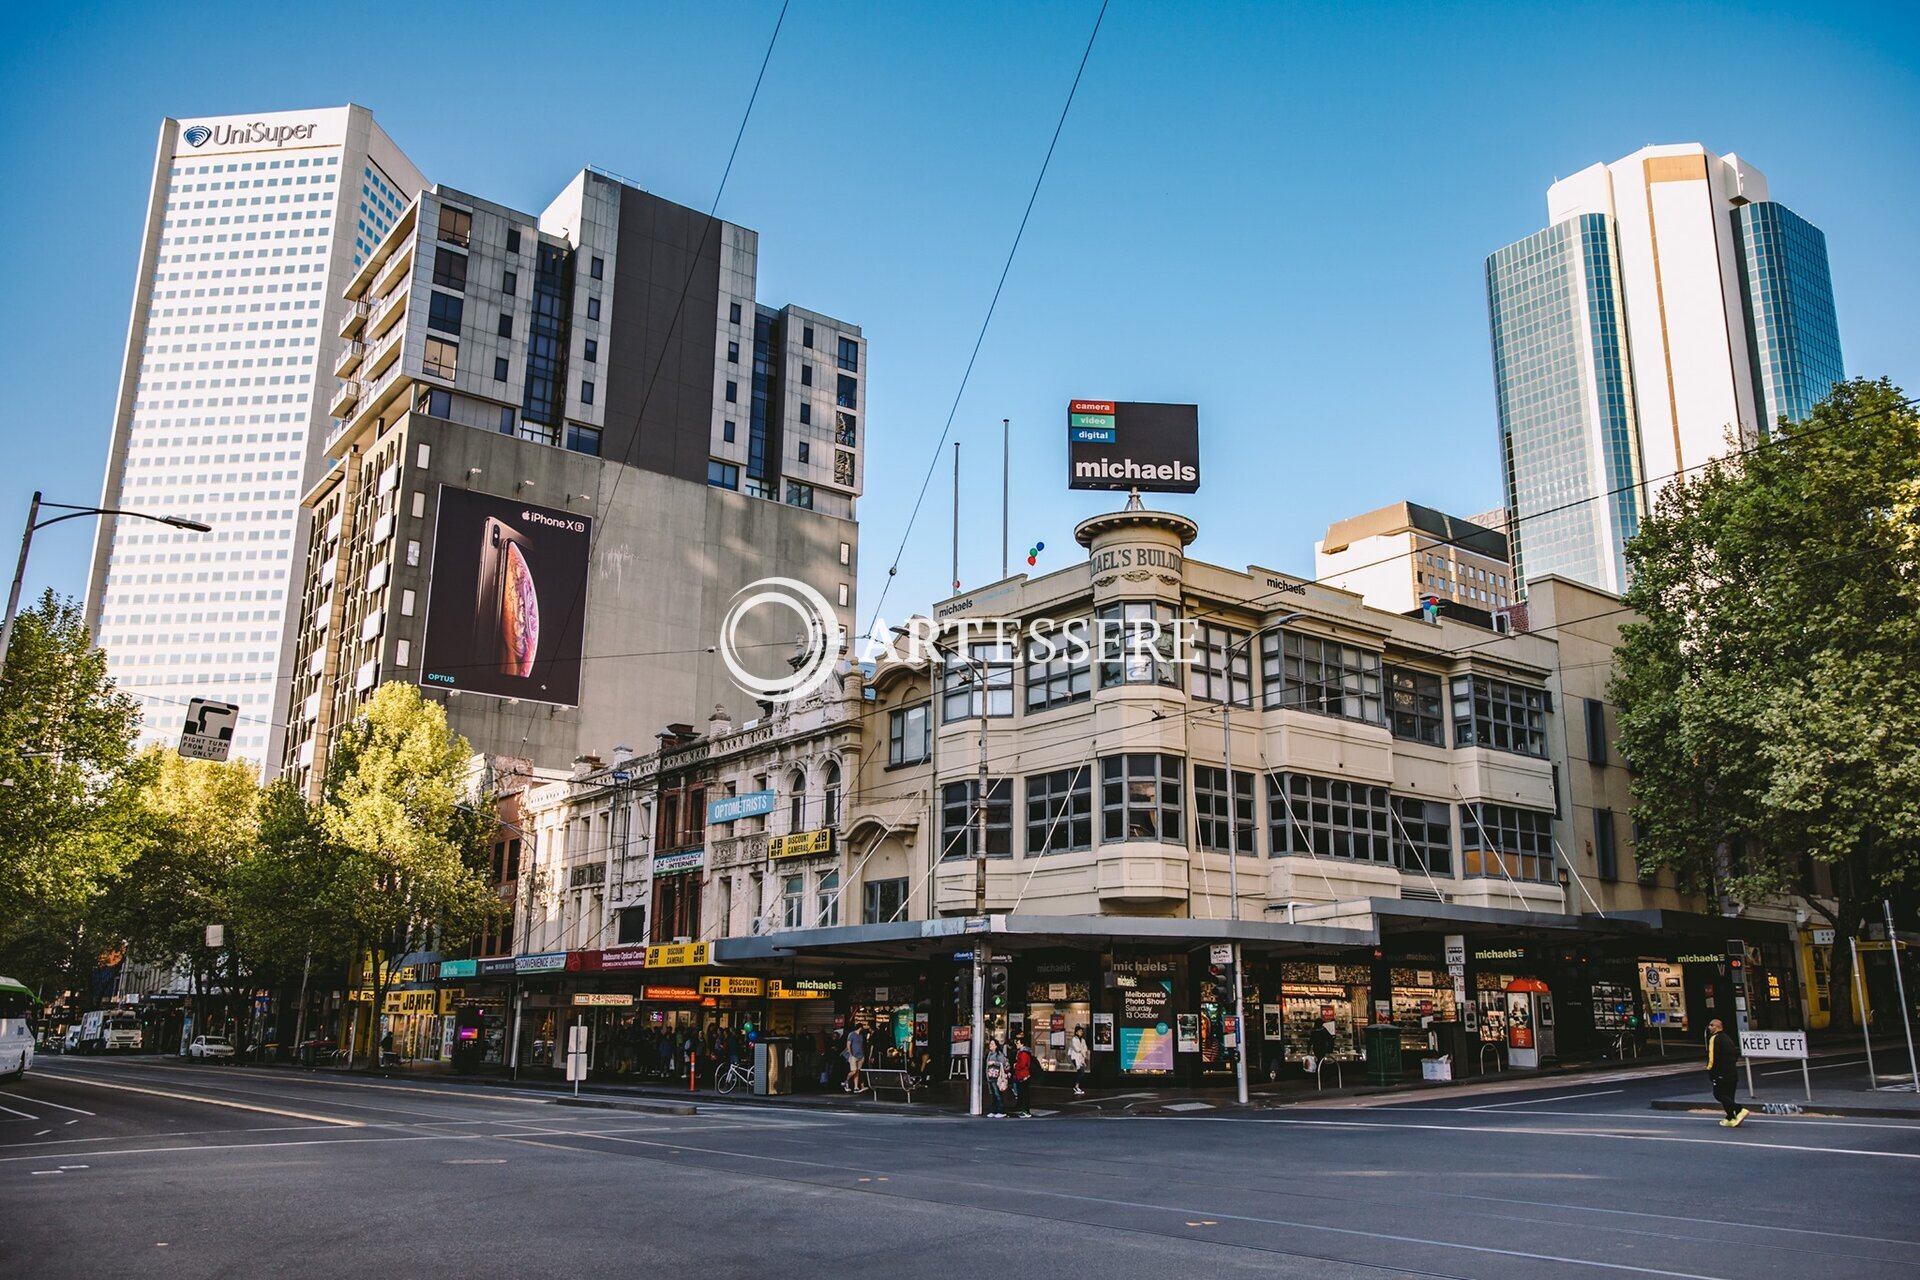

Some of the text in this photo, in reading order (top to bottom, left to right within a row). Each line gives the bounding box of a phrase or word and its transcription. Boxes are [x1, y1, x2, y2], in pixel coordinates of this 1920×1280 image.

[213, 121, 317, 147] UniSuper
[1075, 402, 1110, 411] camera
[1080, 415, 1106, 424] video
[1078, 430, 1109, 440] digital
[1075, 458, 1197, 481] michaels
[530, 511, 566, 528] iPhone
[1266, 578, 1306, 596] michaels
[938, 599, 973, 617] michaels
[428, 673, 455, 683] OPTUS
[182, 742, 204, 750] FROM
[183, 735, 229, 748] RIGHT TURN
[192, 750, 213, 758] ONLY
[714, 795, 768, 819] OPTOMETRISTS
[770, 831, 827, 850] JB DISCOUNT JB
[770, 842, 828, 857] HI-FI CAMERAS HI-FI
[656, 853, 702, 869] 24 CONVENIENCE
[669, 860, 697, 869] INTERNET
[602, 953, 621, 961] Melbourne
[621, 952, 634, 961] Optical
[648, 945, 705, 959] JB DISCOUNT JB
[1475, 949, 1518, 959] michaels
[666, 956, 685, 964] CAMERAS
[1678, 954, 1719, 963] michaels
[1037, 963, 1072, 972] michaels
[1113, 958, 1168, 971] michaels
[1648, 973, 1657, 981] 40
[703, 978, 758, 987] JB DISCOUNT
[769, 981, 780, 991] JB
[796, 980, 837, 990] michaels
[728, 986, 758, 994] CAMERAS
[402, 994, 415, 1011] JB
[415, 993, 435, 1011] HI-FI
[1125, 1005, 1153, 1013] Saturday
[1742, 1038, 1804, 1051] KEEP LEFT
